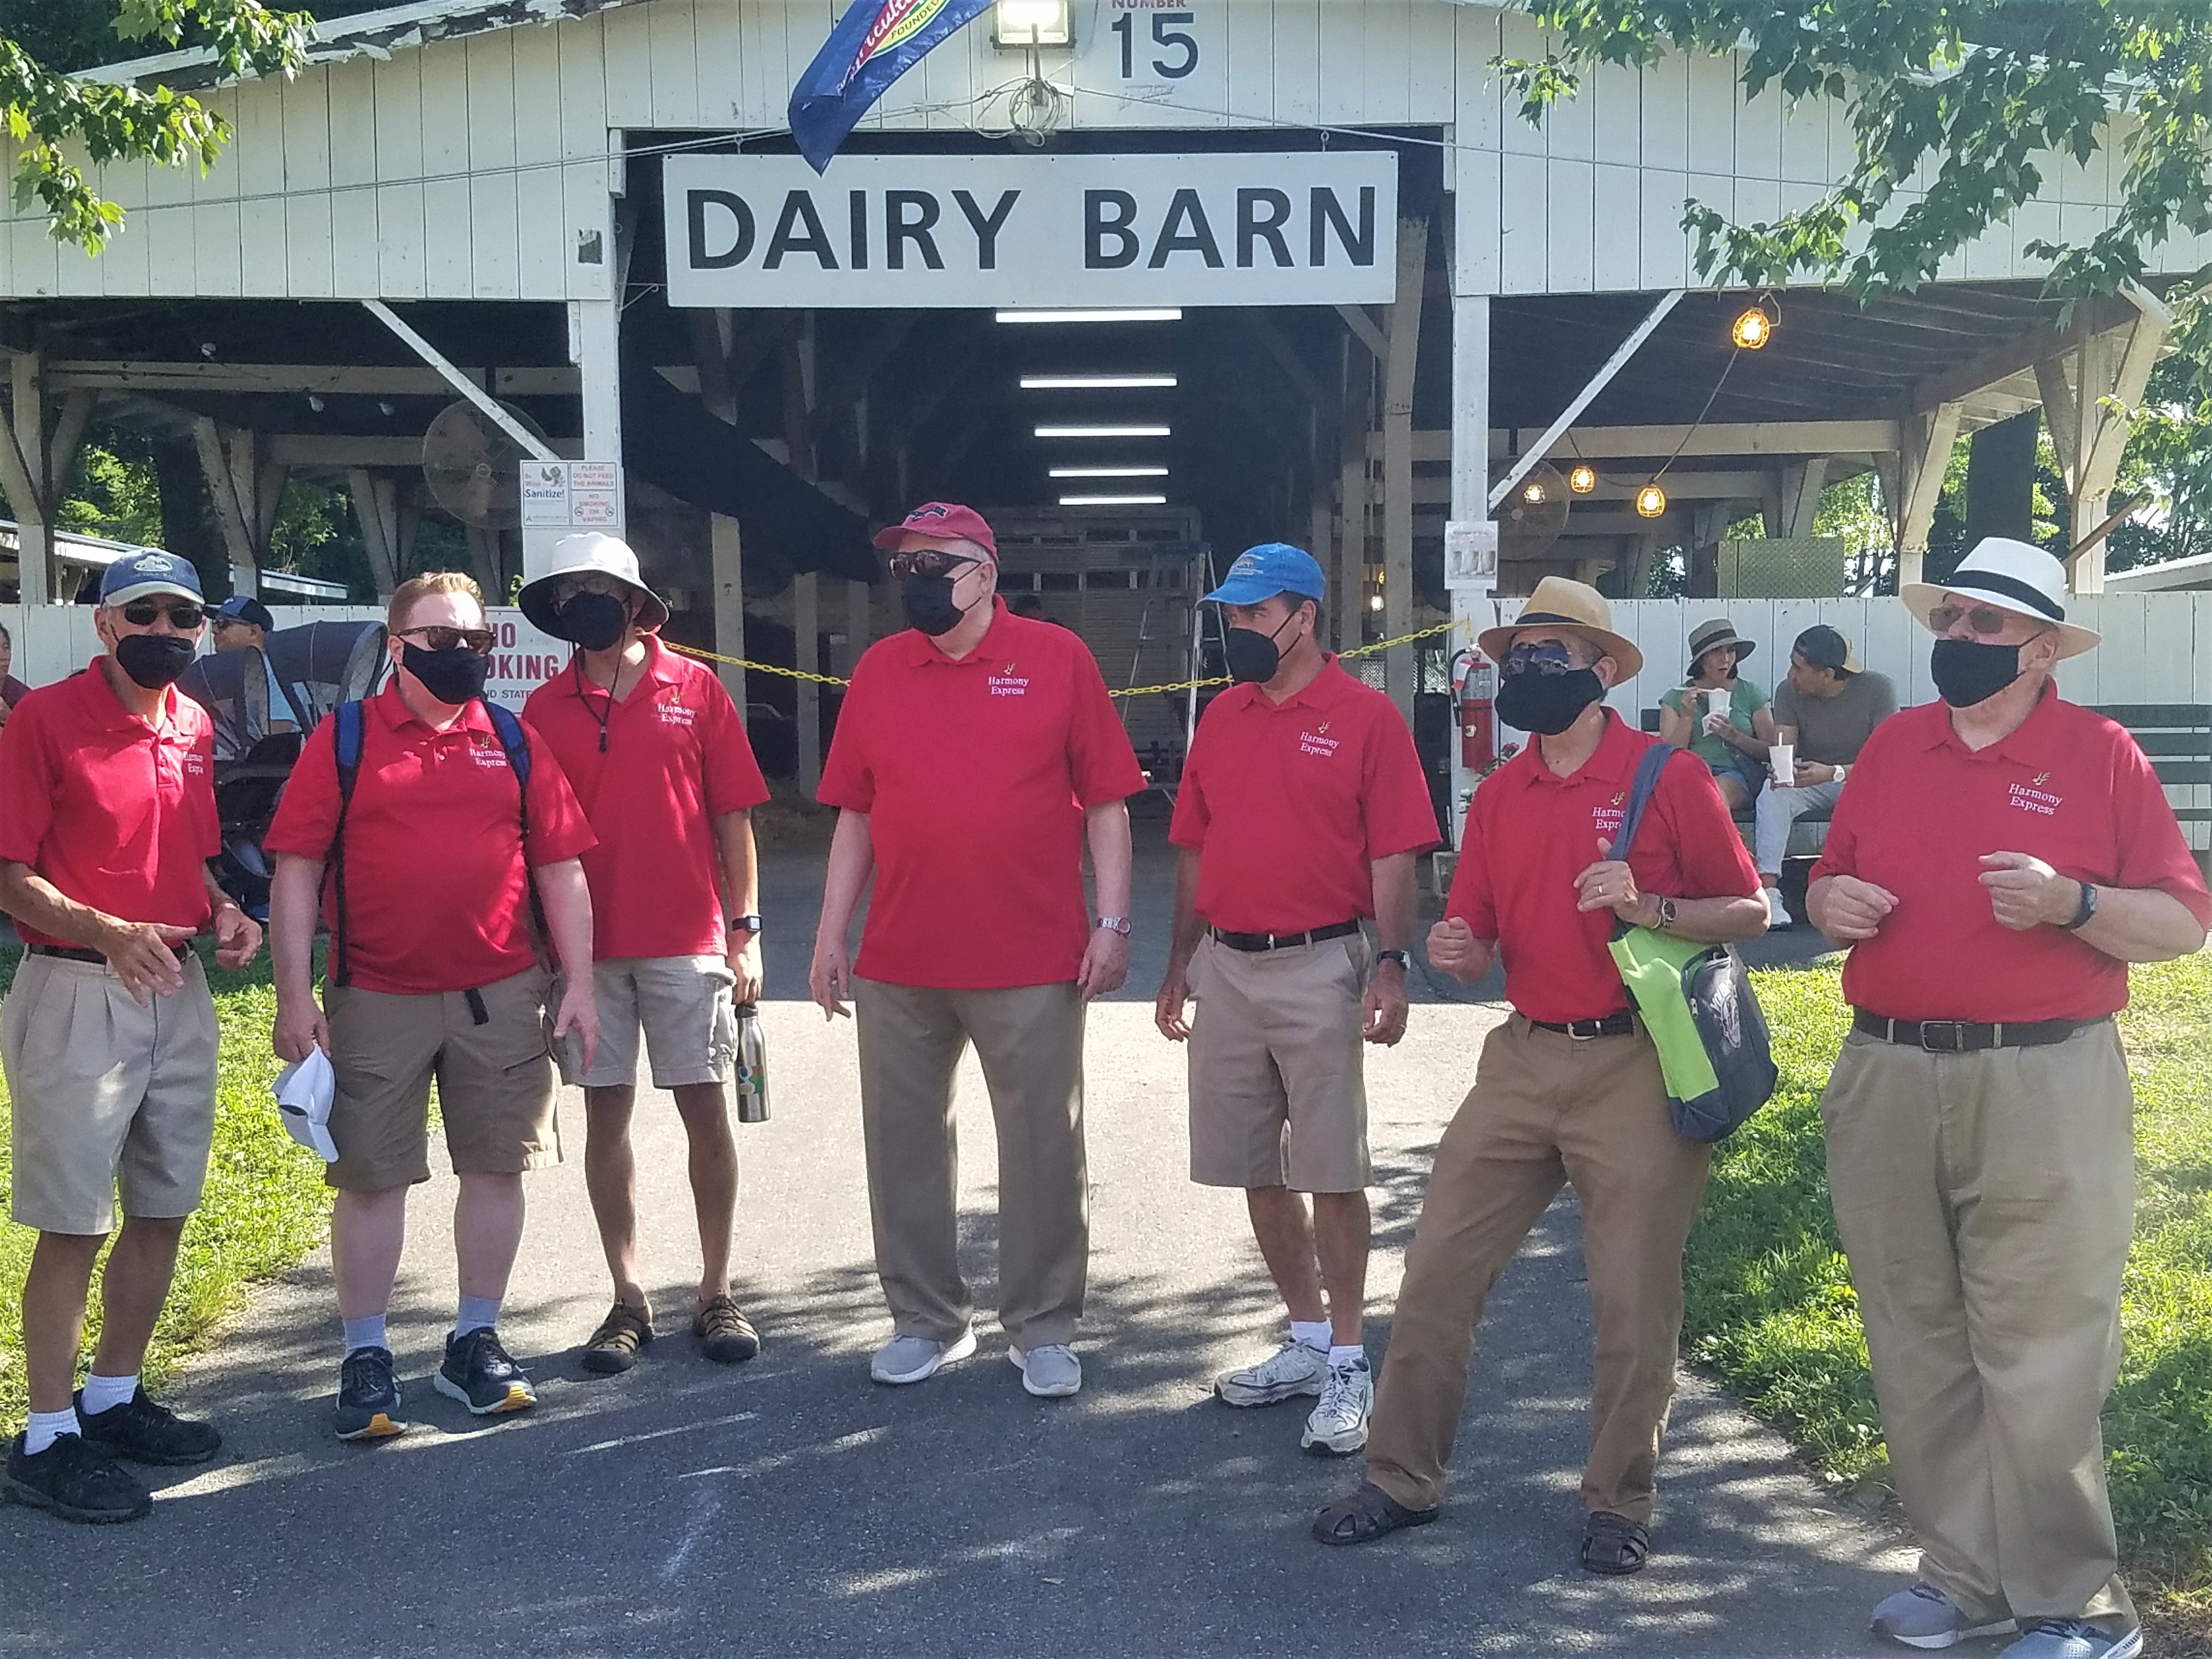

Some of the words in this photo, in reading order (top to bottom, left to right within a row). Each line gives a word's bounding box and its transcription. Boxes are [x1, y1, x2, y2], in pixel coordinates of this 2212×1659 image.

[1111, 0, 1186, 8] NUMBER
[1111, 12, 1198, 78] 15
[687, 189, 1021, 269] DAIRY
[1084, 187, 1375, 268] BARN
[525, 489, 565, 498] Sanitize!
[988, 676, 1029, 687] Harmony
[991, 686, 1025, 697] Express
[658, 703, 696, 719] Harmony
[1300, 731, 1340, 749] Harmony
[1300, 742, 1333, 757] Express
[2008, 782, 2063, 807] Harmony
[2010, 795, 2055, 815] Express
